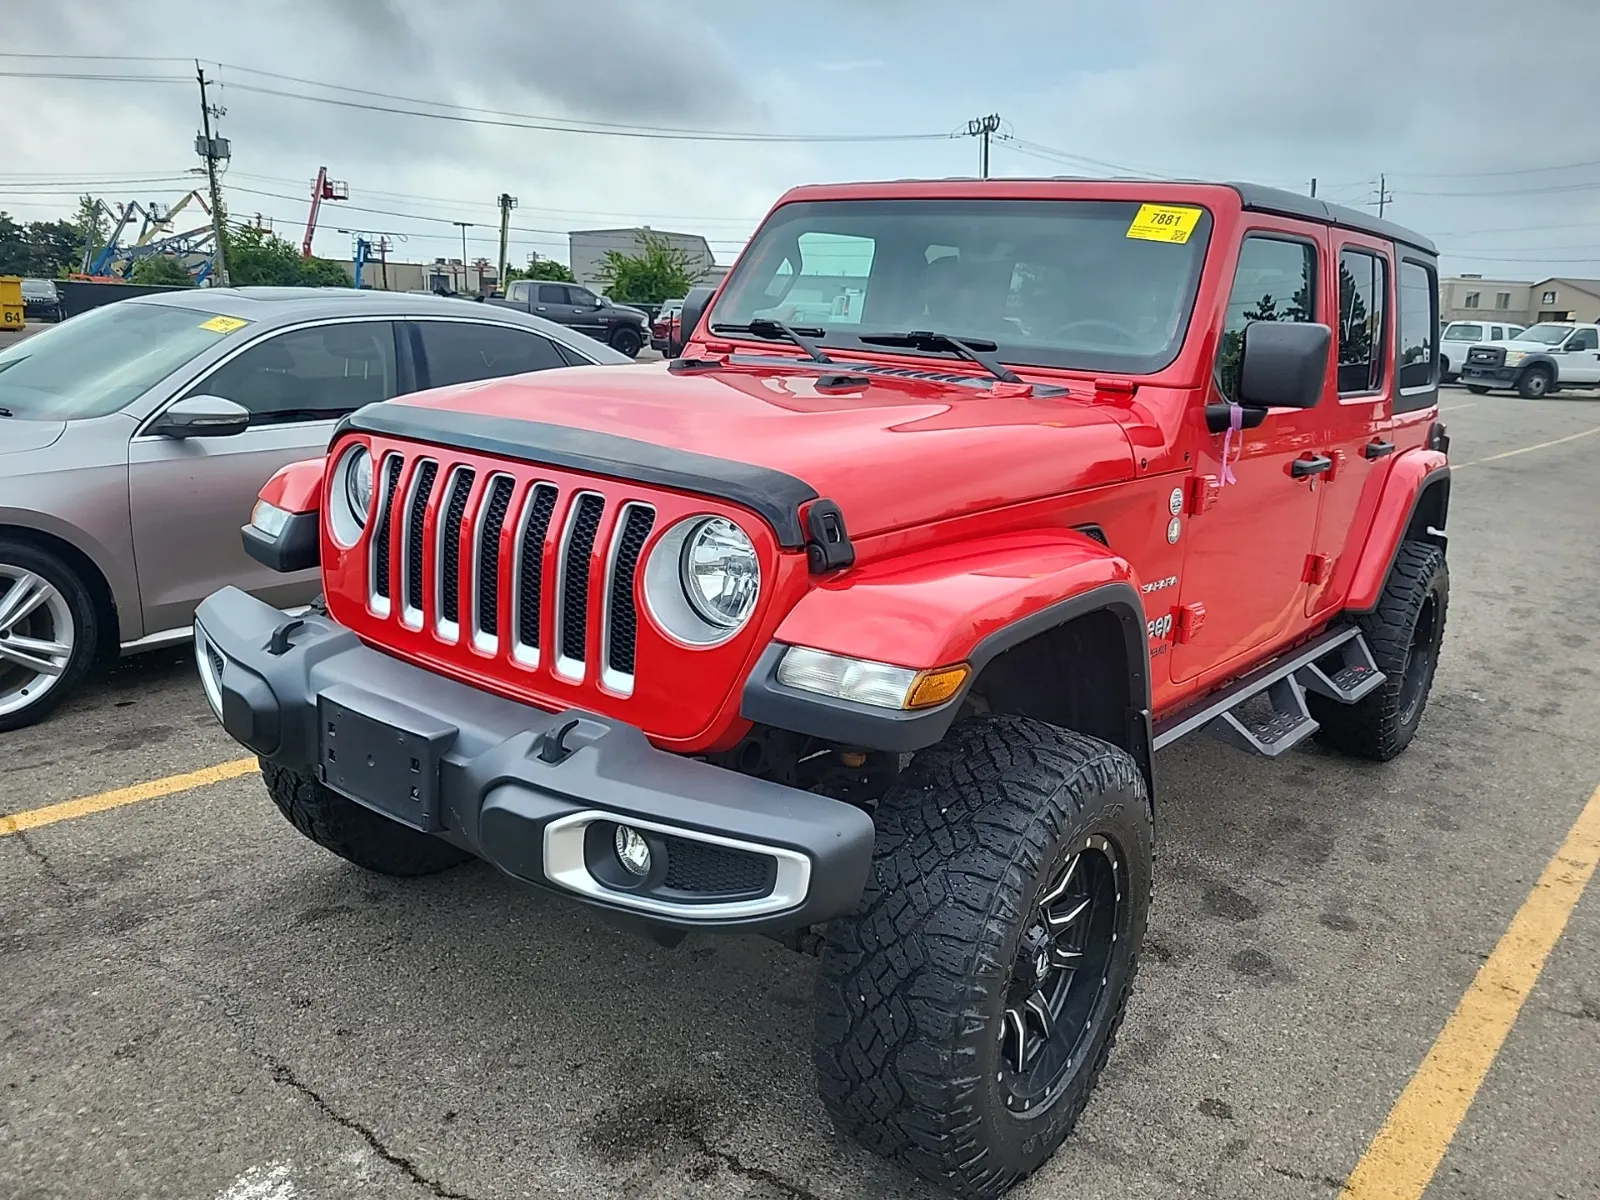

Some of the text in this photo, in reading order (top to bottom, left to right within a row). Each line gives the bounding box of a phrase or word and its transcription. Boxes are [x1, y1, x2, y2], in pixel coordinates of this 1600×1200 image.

[1150, 212, 1182, 226] 7881
[4, 311, 21, 323] 64
[1146, 612, 1173, 640] eep
